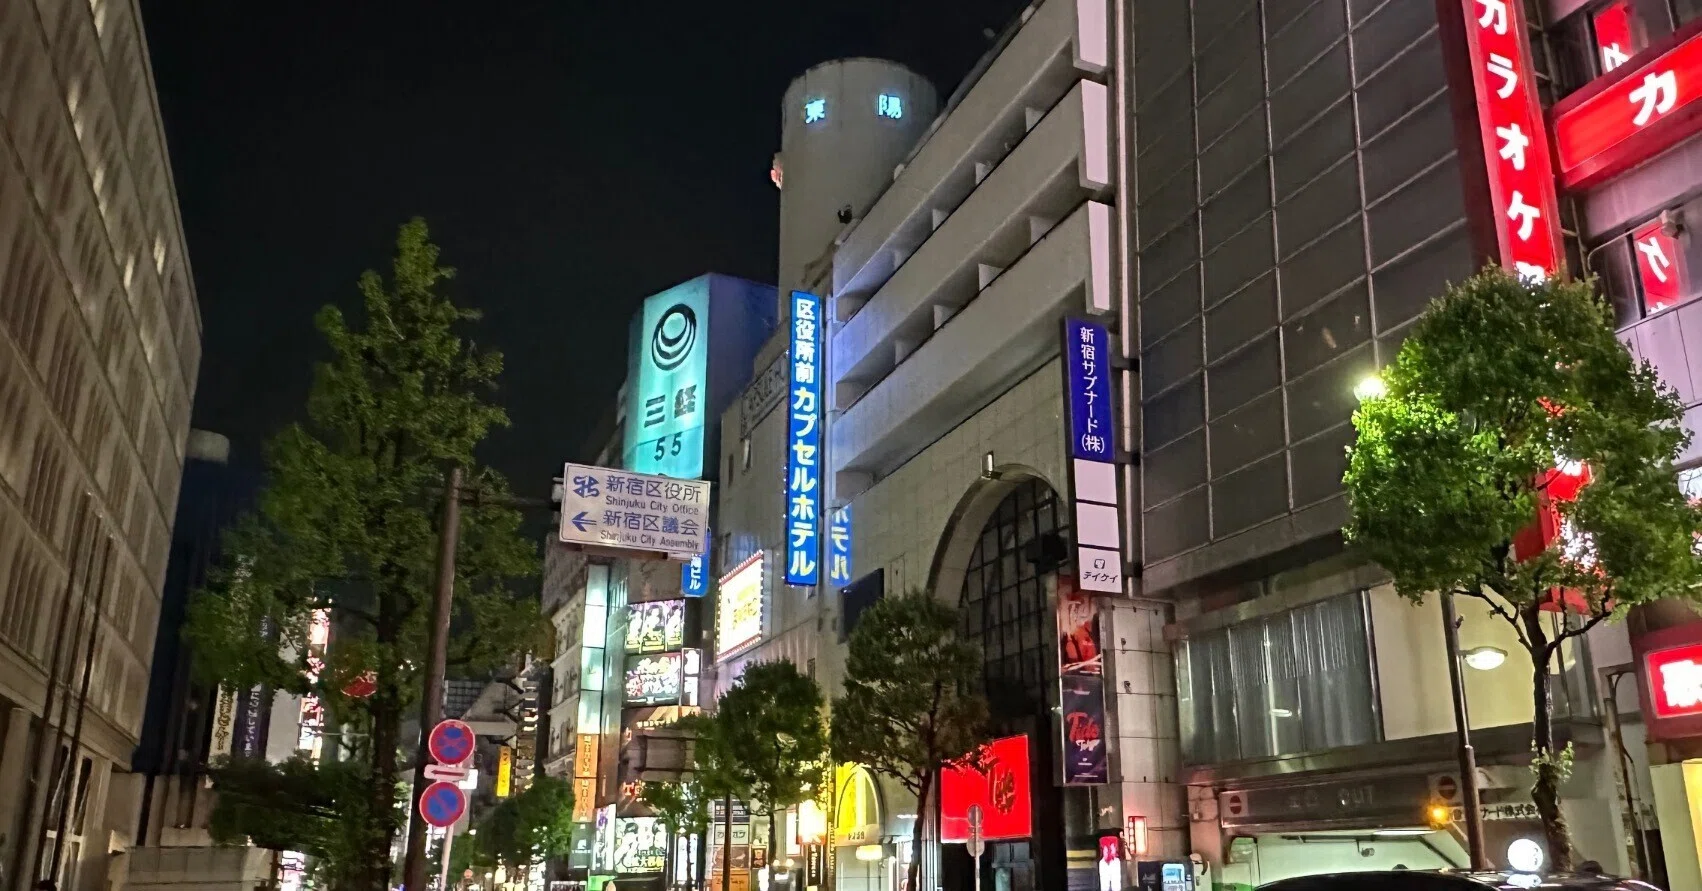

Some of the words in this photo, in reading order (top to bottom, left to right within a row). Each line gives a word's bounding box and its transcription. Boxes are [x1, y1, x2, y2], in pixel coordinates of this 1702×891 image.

[1628, 70, 1678, 126] カ
[1079, 326, 1106, 454] 新宿サブナード(株)
[654, 432, 683, 462] 55
[790, 298, 818, 577] 区役所前カプセルホテル
[605, 475, 702, 504] 新宿区役所
[605, 496, 646, 510] Shinjuku
[650, 500, 668, 513] City
[672, 503, 699, 516] Office
[602, 510, 700, 537] 新宿区議会
[600, 531, 637, 545] Shinjuku
[640, 535, 656, 547] City
[659, 538, 700, 551] Assembly
[1083, 571, 1118, 584] テイケイ
